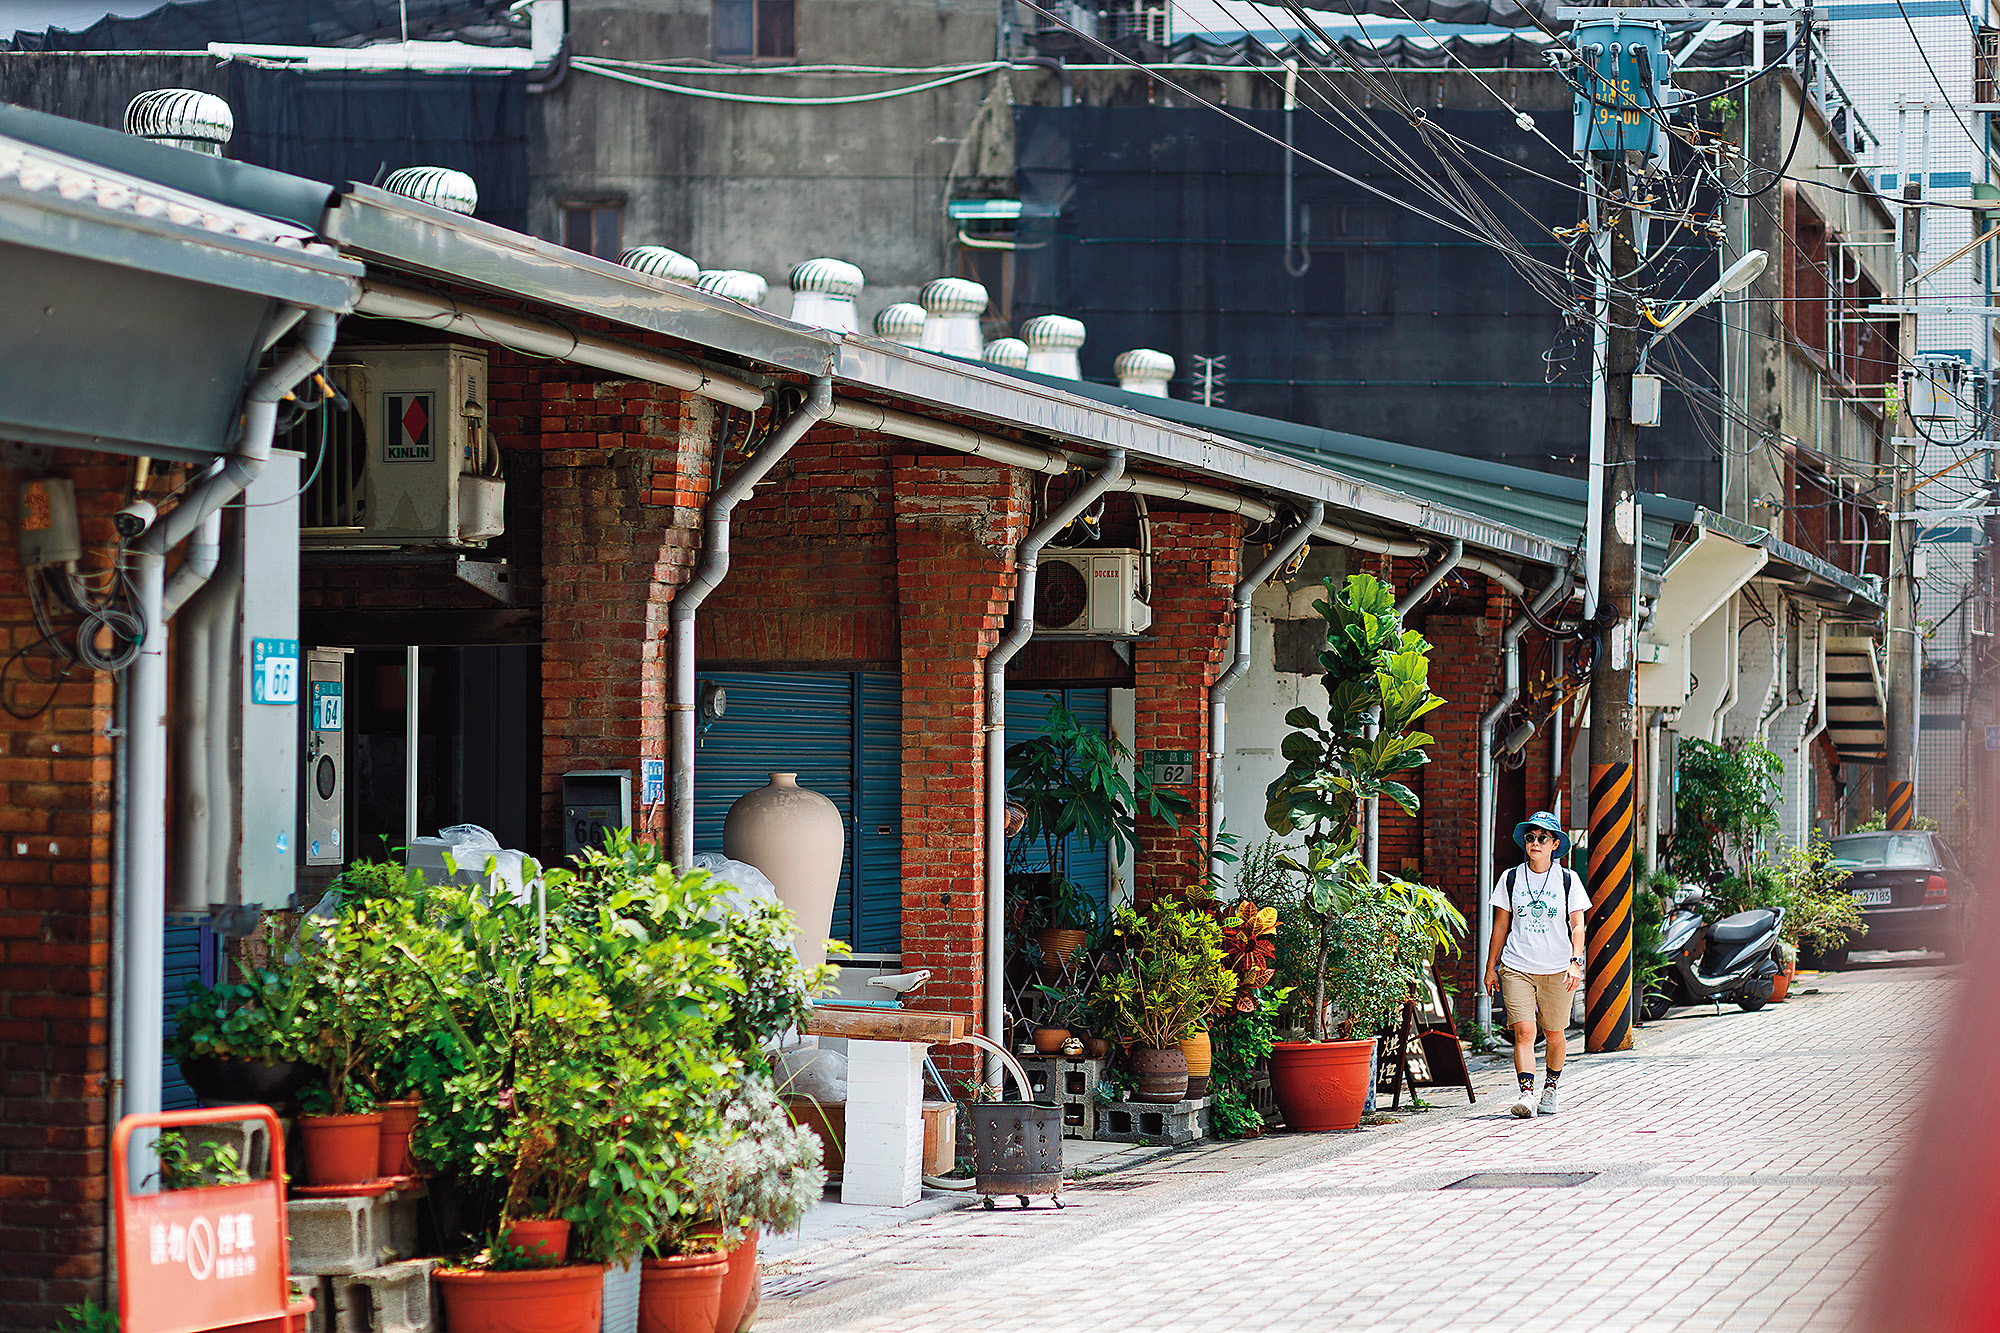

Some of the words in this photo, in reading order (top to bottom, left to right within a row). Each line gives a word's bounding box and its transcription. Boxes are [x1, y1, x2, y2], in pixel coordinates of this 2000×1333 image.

[388, 447, 429, 458] KINLIN
[1094, 570, 1119, 578] DUCKER
[273, 664, 290, 695] 66
[326, 699, 338, 725] 64
[1155, 752, 1192, 763] 永昌街
[1163, 766, 1185, 782] 62
[575, 820, 603, 845] 66
[217, 1212, 256, 1256] 停車
